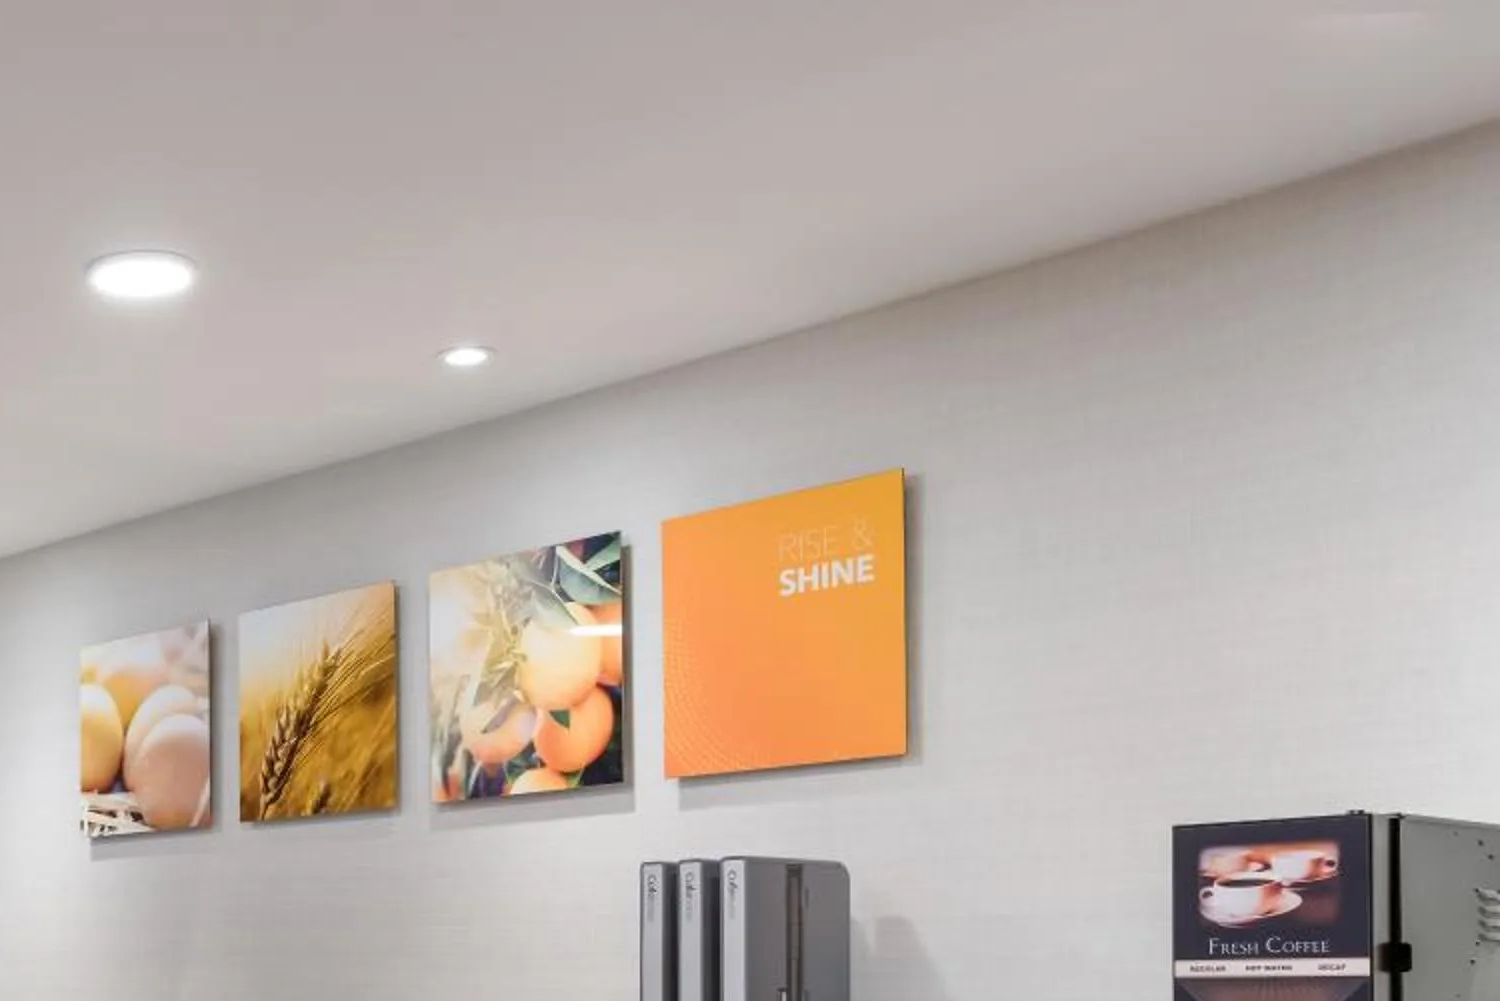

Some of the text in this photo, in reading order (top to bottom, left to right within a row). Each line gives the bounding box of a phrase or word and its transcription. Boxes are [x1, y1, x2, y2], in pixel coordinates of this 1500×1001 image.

[779, 516, 874, 562] RISE &
[778, 553, 876, 598] SHINE
